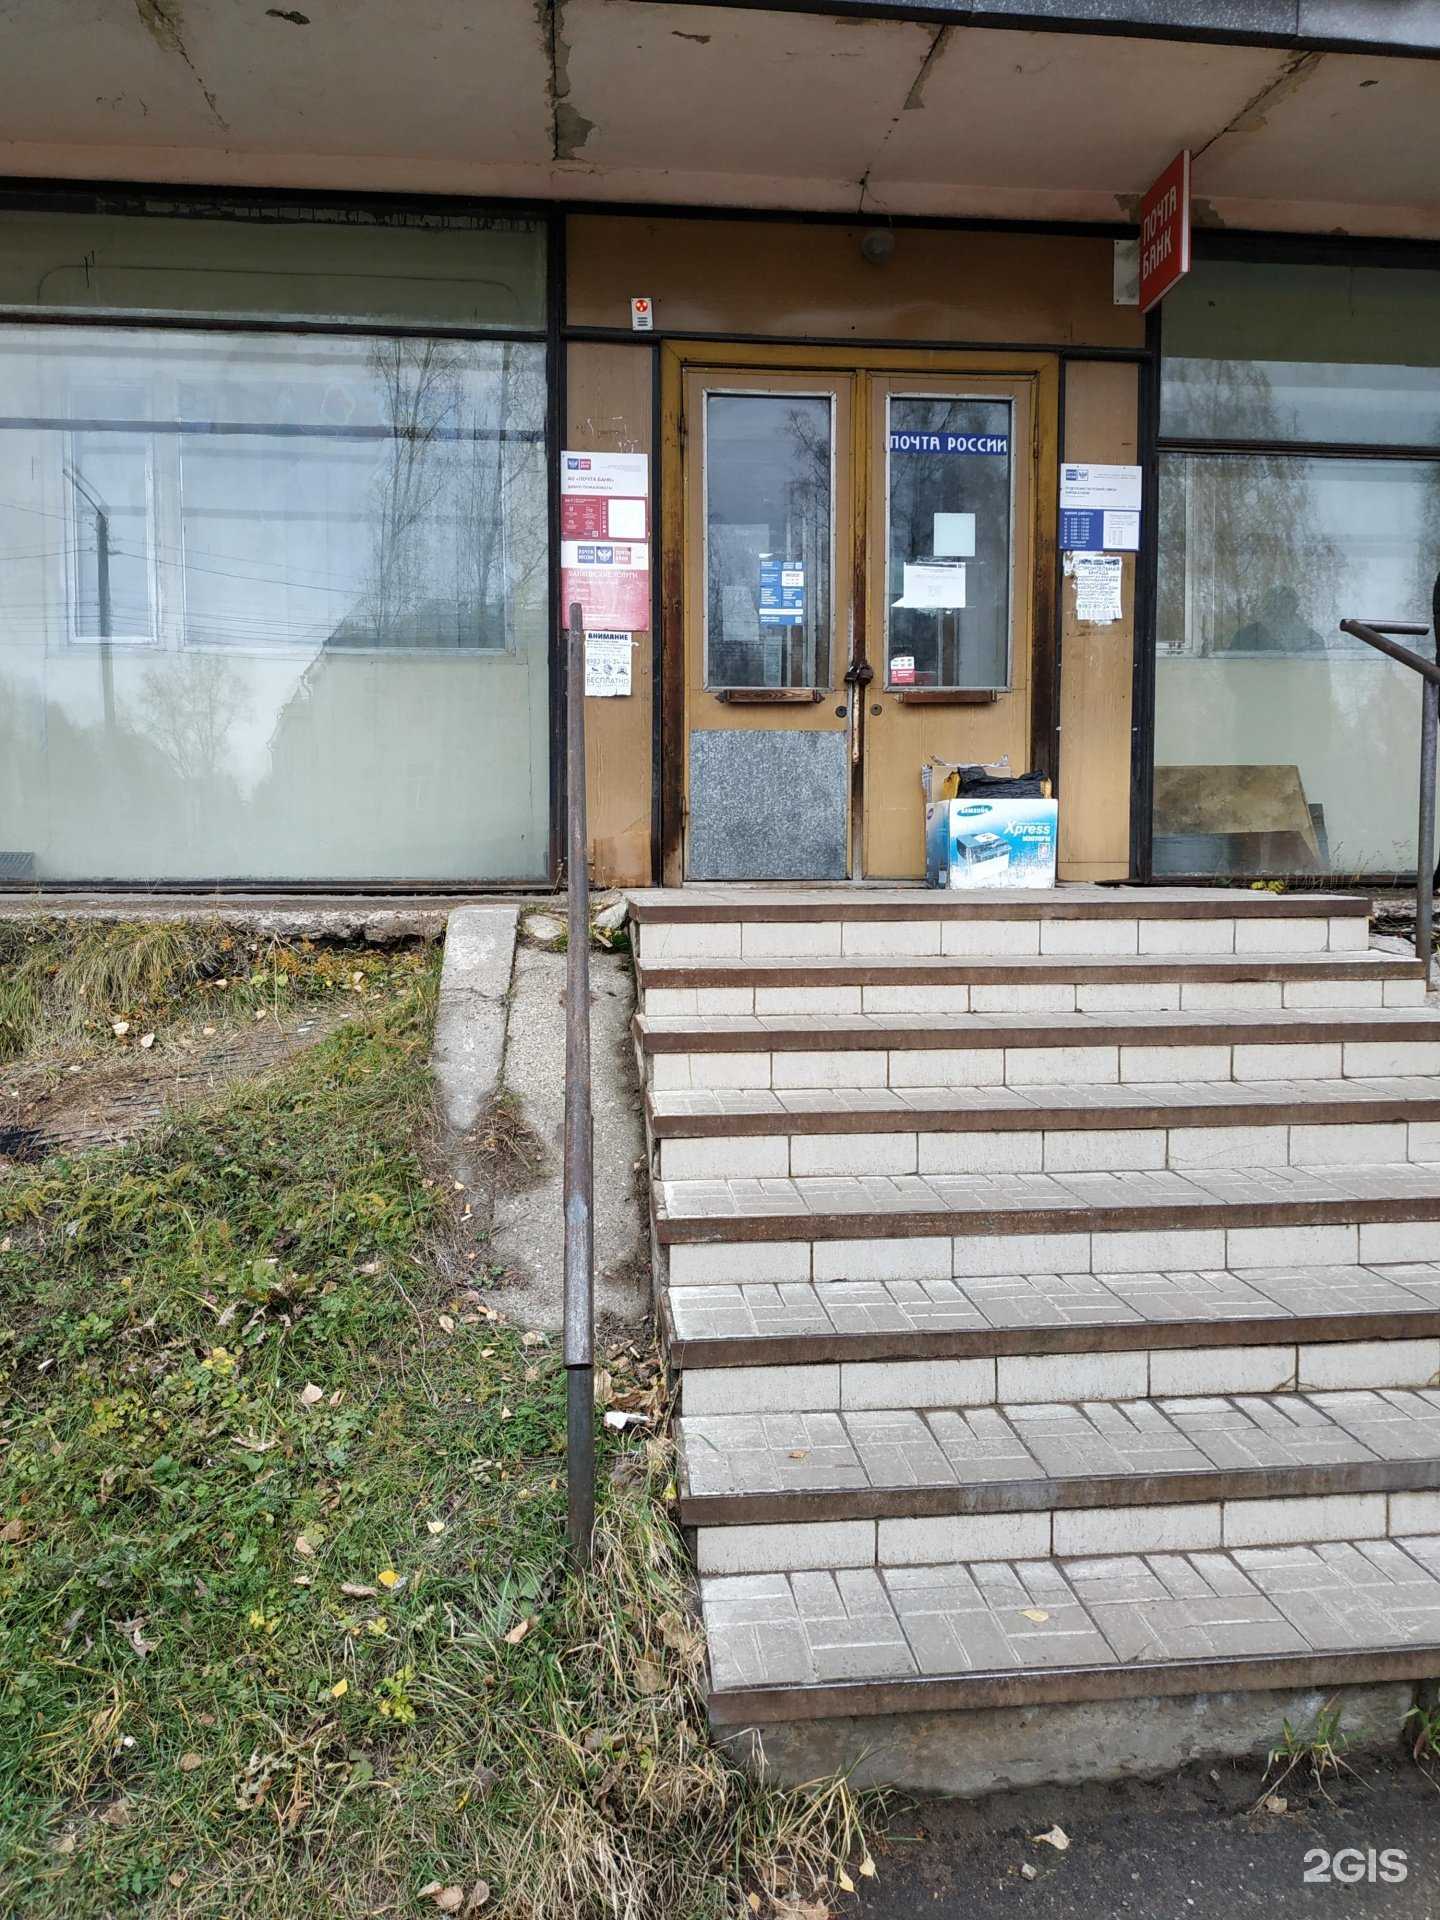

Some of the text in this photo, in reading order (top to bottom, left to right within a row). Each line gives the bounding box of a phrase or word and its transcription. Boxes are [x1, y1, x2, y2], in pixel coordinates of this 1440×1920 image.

[1143, 185, 1177, 246] ПОЧТА
[1142, 225, 1173, 281] БАНК
[890, 435, 1007, 452] ПОЧТА РОССИИ
[588, 632, 629, 640] ВНИМАНИЕ
[1003, 820, 1051, 836] Xpress
